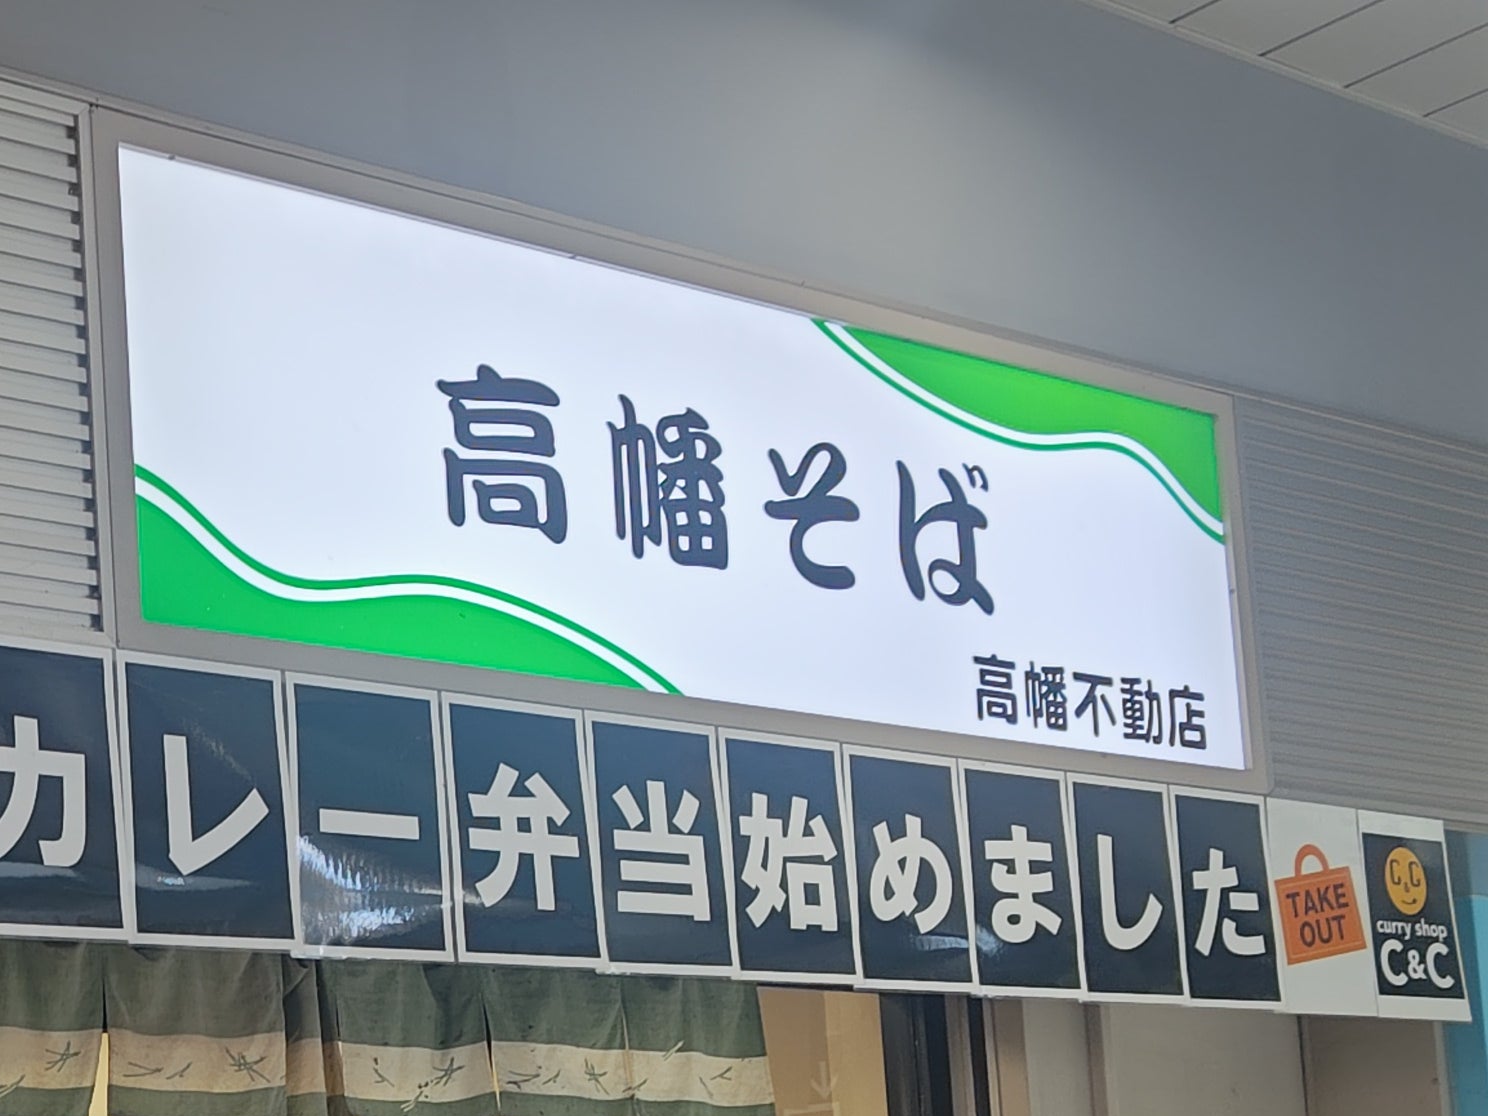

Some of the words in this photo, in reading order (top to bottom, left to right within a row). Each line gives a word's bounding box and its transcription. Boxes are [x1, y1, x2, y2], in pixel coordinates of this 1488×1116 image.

[436, 364, 995, 615] 高幡そば
[973, 654, 1208, 751] 高幡不動店
[1286, 883, 1349, 918] TAKE
[1300, 915, 1346, 948] OUT
[1376, 919, 1412, 940] curry
[1414, 917, 1448, 941] shop
[1380, 938, 1455, 989] C&C
